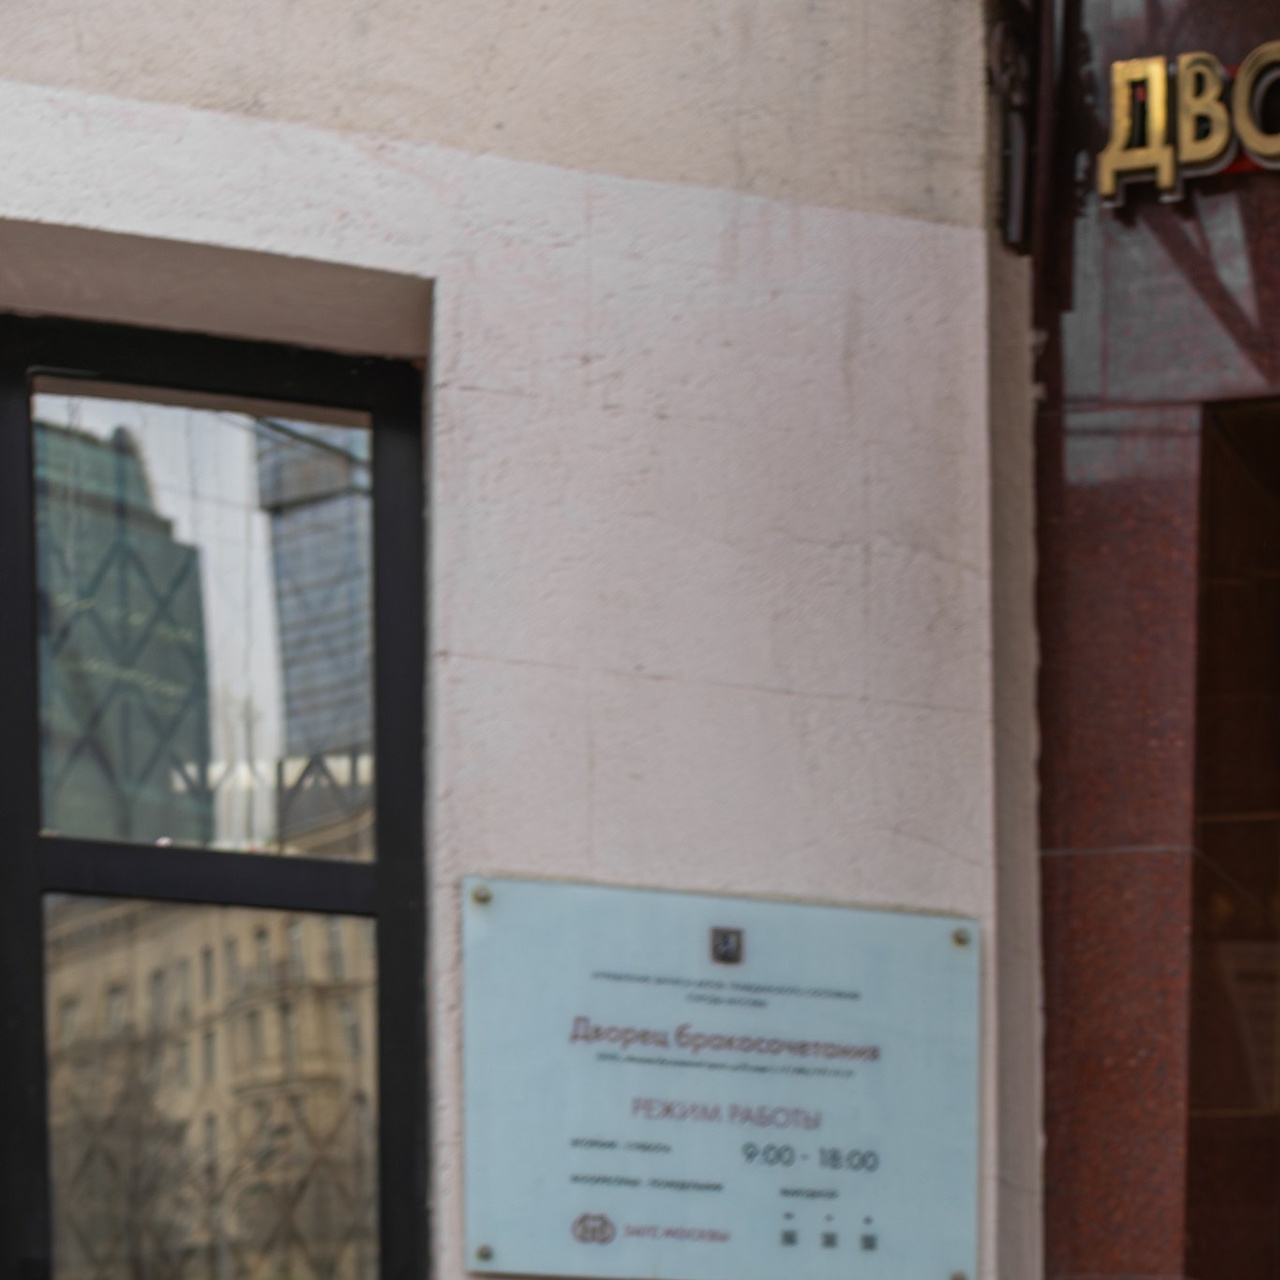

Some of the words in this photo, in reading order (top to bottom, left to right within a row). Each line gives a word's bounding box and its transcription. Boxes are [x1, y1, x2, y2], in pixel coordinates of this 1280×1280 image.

[571, 1015, 669, 1050] Дворец
[673, 1021, 881, 1062] бракосочетания
[631, 1097, 723, 1124] РЕЖИМ
[727, 1103, 823, 1130] РАБОТЫ
[741, 1141, 796, 1168] 9:00
[818, 1147, 880, 1173] 18:00
